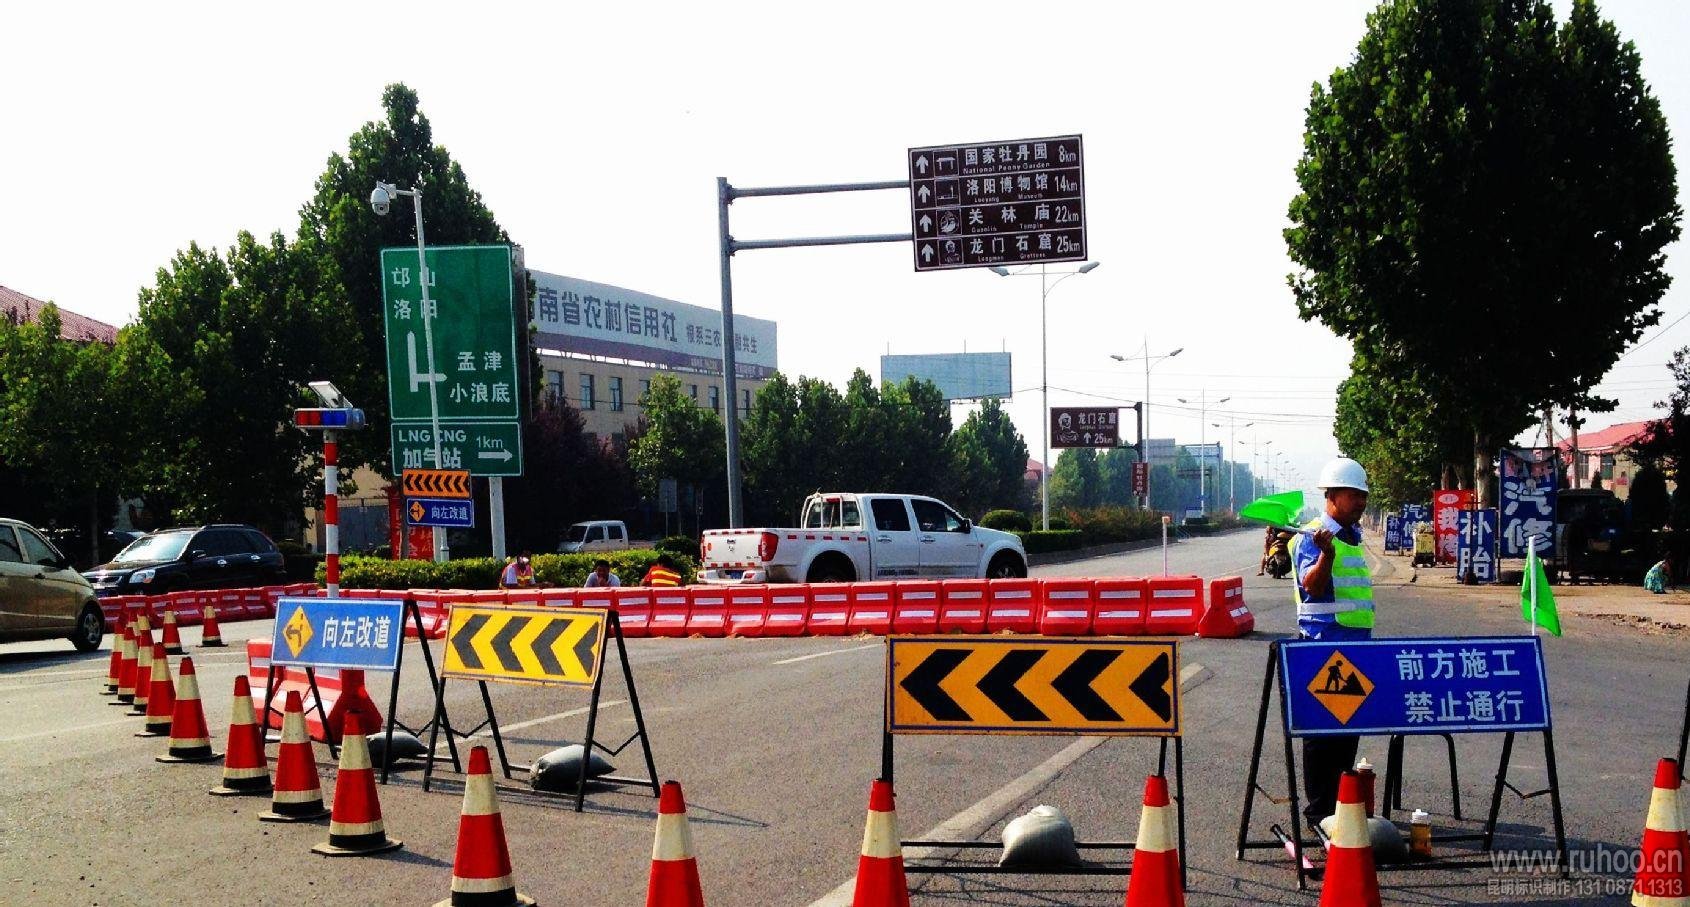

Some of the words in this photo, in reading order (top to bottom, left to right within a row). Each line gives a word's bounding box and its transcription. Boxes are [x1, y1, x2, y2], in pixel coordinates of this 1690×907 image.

[965, 143, 1048, 166] 国家牡丹园
[1058, 144, 1076, 163] 8km
[966, 172, 1048, 196] 洛阳博物馆
[1054, 174, 1078, 192] 14km
[968, 203, 1050, 225] 关林庙
[1055, 205, 1079, 223] 22km
[969, 232, 1052, 254] 龙门石窟
[1057, 235, 1081, 253] 25km
[393, 299, 438, 320] 洛阳
[533, 286, 678, 343] 南省农村信用社
[457, 351, 503, 372] 孟津
[449, 381, 511, 404] 小浪底
[399, 429, 431, 443] LNG
[476, 434, 504, 449] 1km
[402, 447, 462, 469] 加气站
[431, 505, 469, 521] 向左改道
[1458, 511, 1493, 579] 补胎
[322, 615, 391, 649] 向左改道
[1395, 648, 1521, 681] 前方施工
[1404, 690, 1524, 724] 禁止通行
